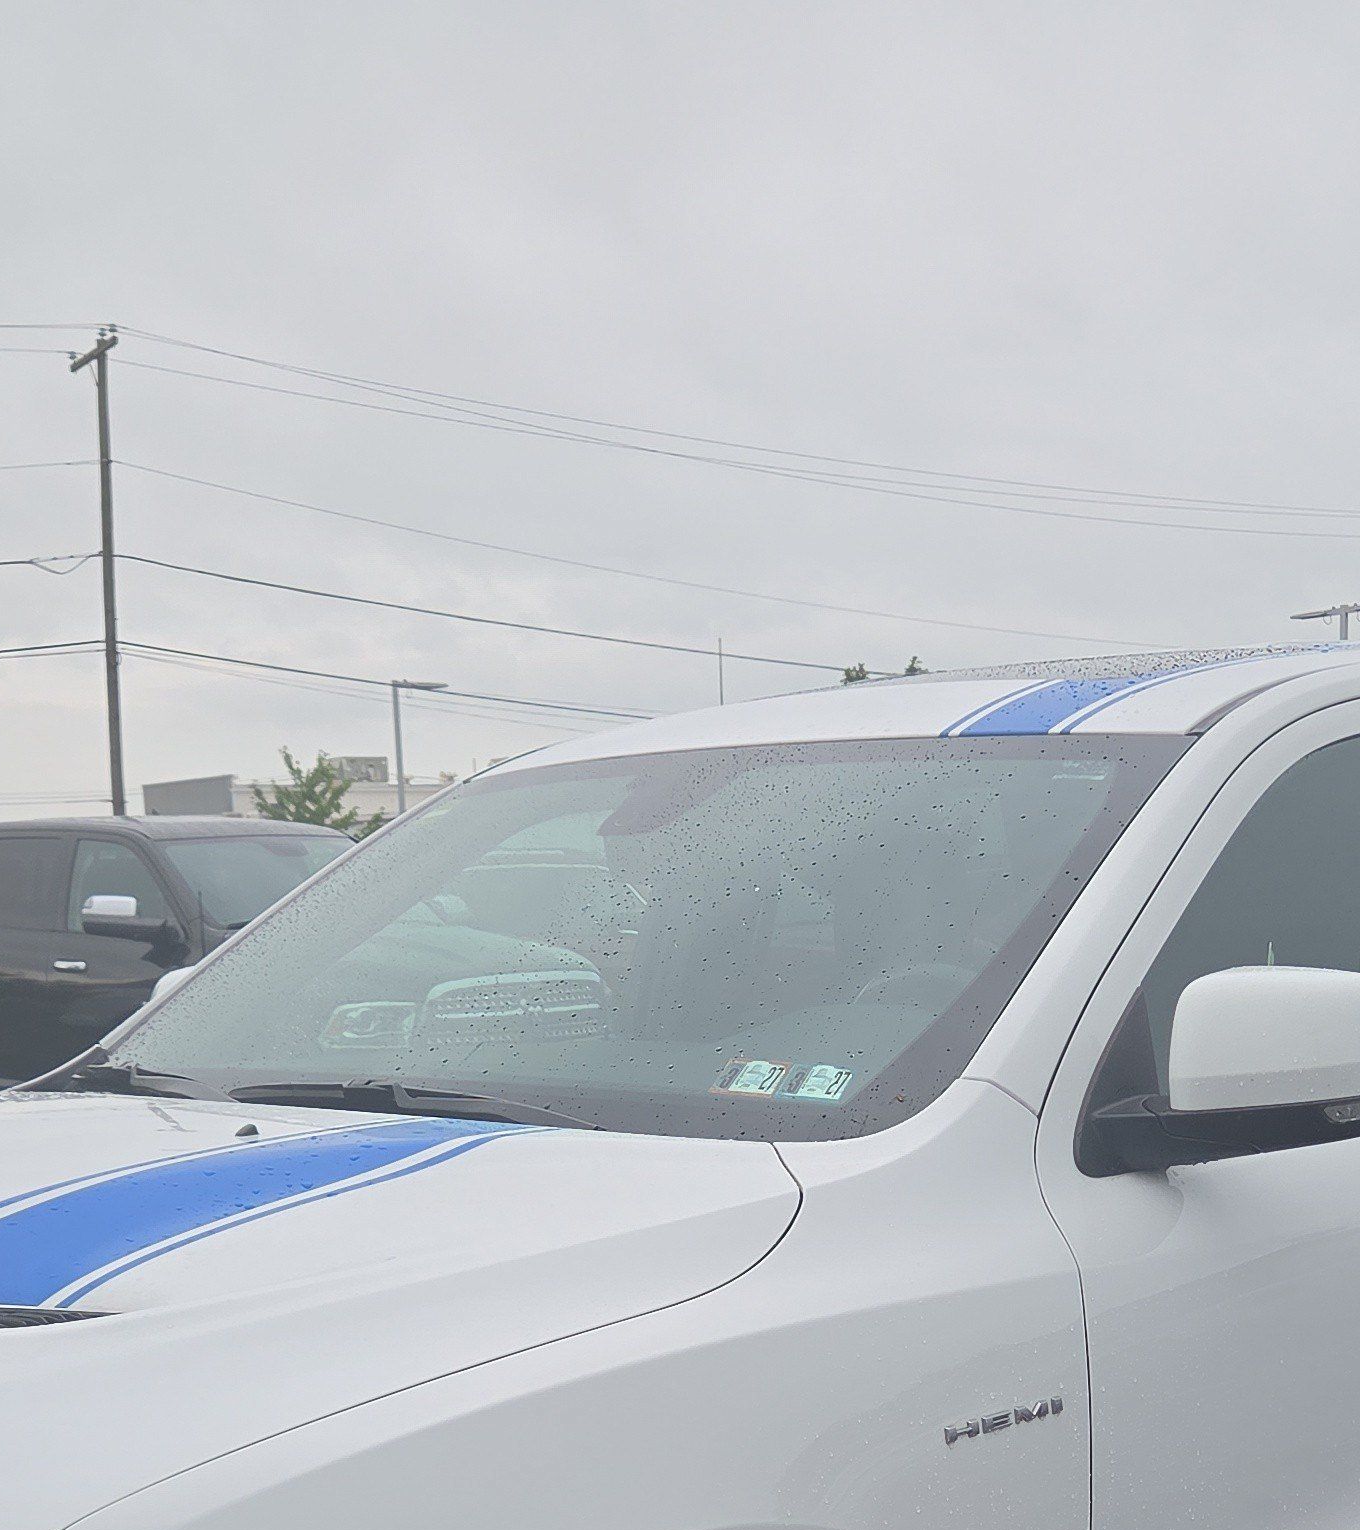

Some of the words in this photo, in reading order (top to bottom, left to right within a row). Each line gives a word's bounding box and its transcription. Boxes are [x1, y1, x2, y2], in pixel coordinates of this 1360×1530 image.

[758, 1066, 785, 1092] 27
[824, 1071, 852, 1096] 27
[943, 1396, 1064, 1446] HEMI
